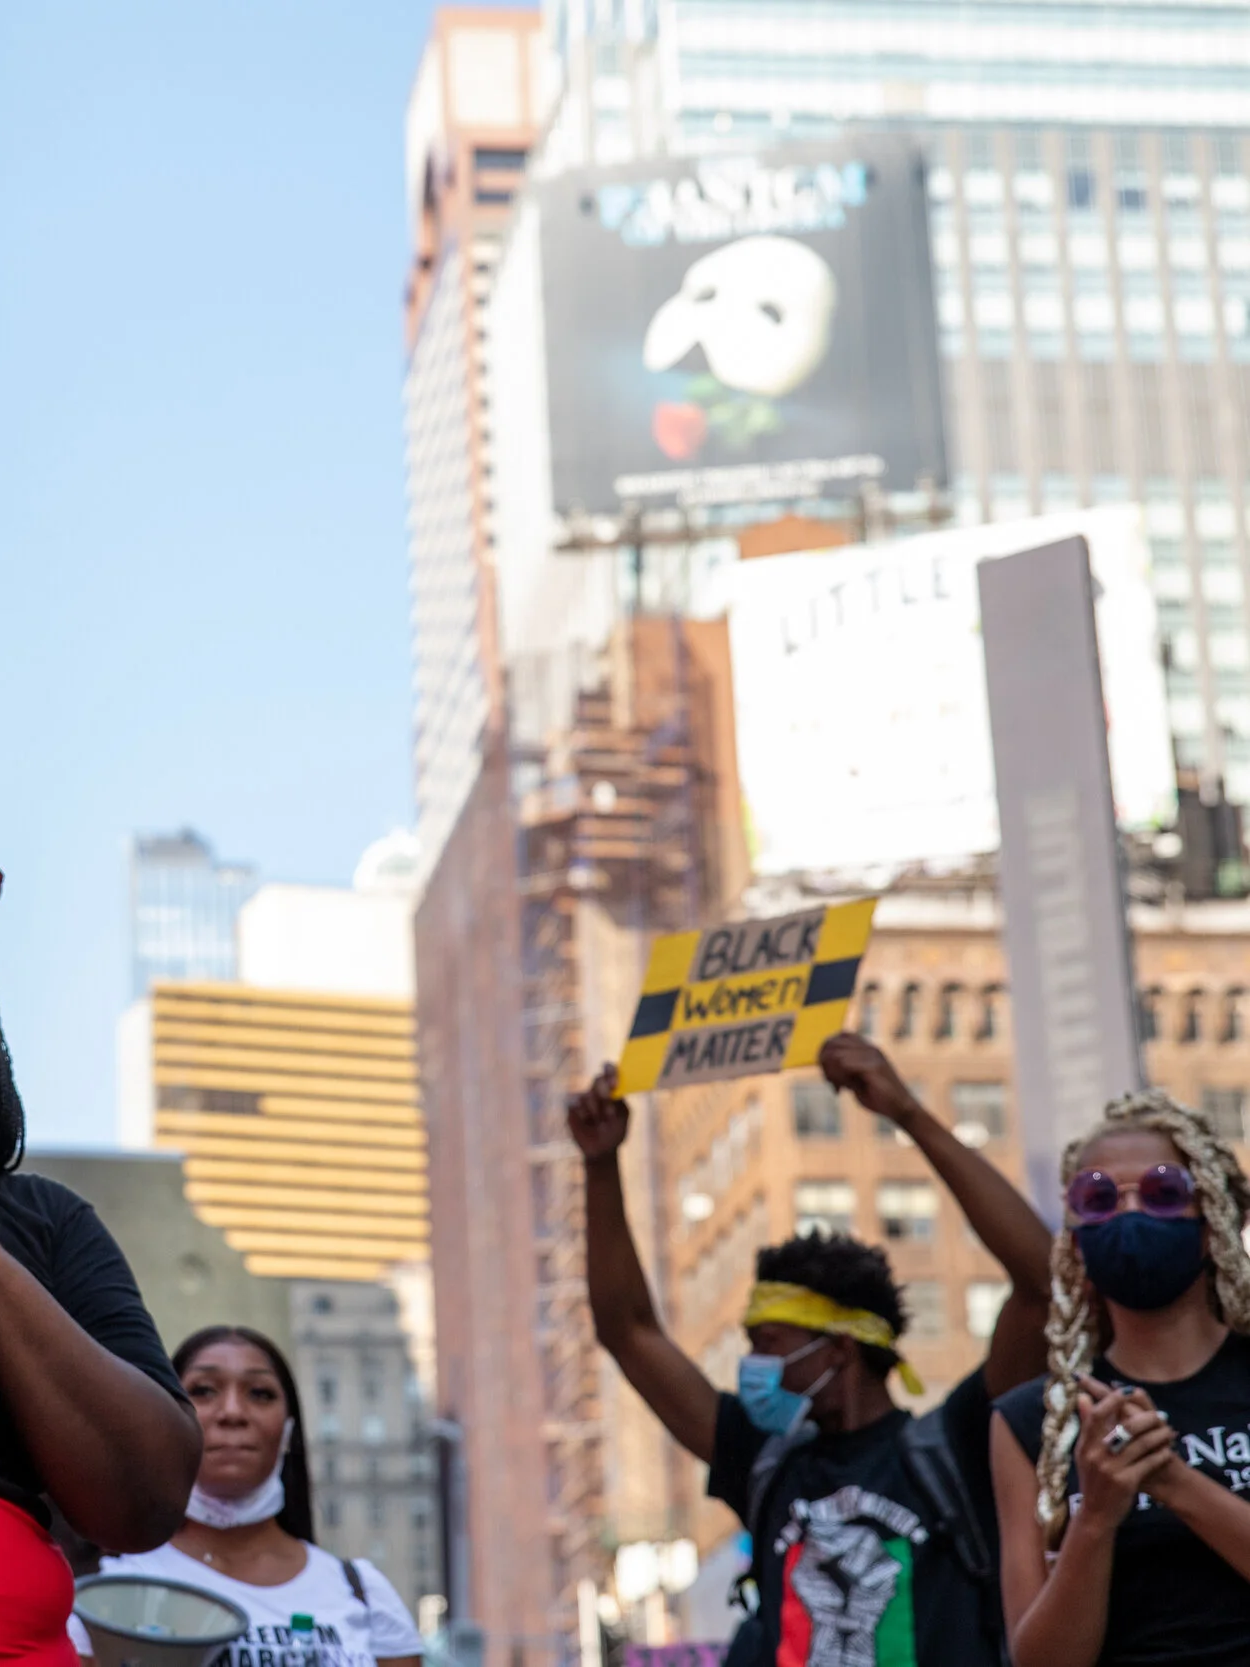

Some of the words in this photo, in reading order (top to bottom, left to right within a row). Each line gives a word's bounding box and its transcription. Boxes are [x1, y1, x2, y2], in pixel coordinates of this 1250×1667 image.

[699, 915, 826, 982] BLACK
[662, 1020, 794, 1078] MATTER
[1181, 1423, 1250, 1467] Na
